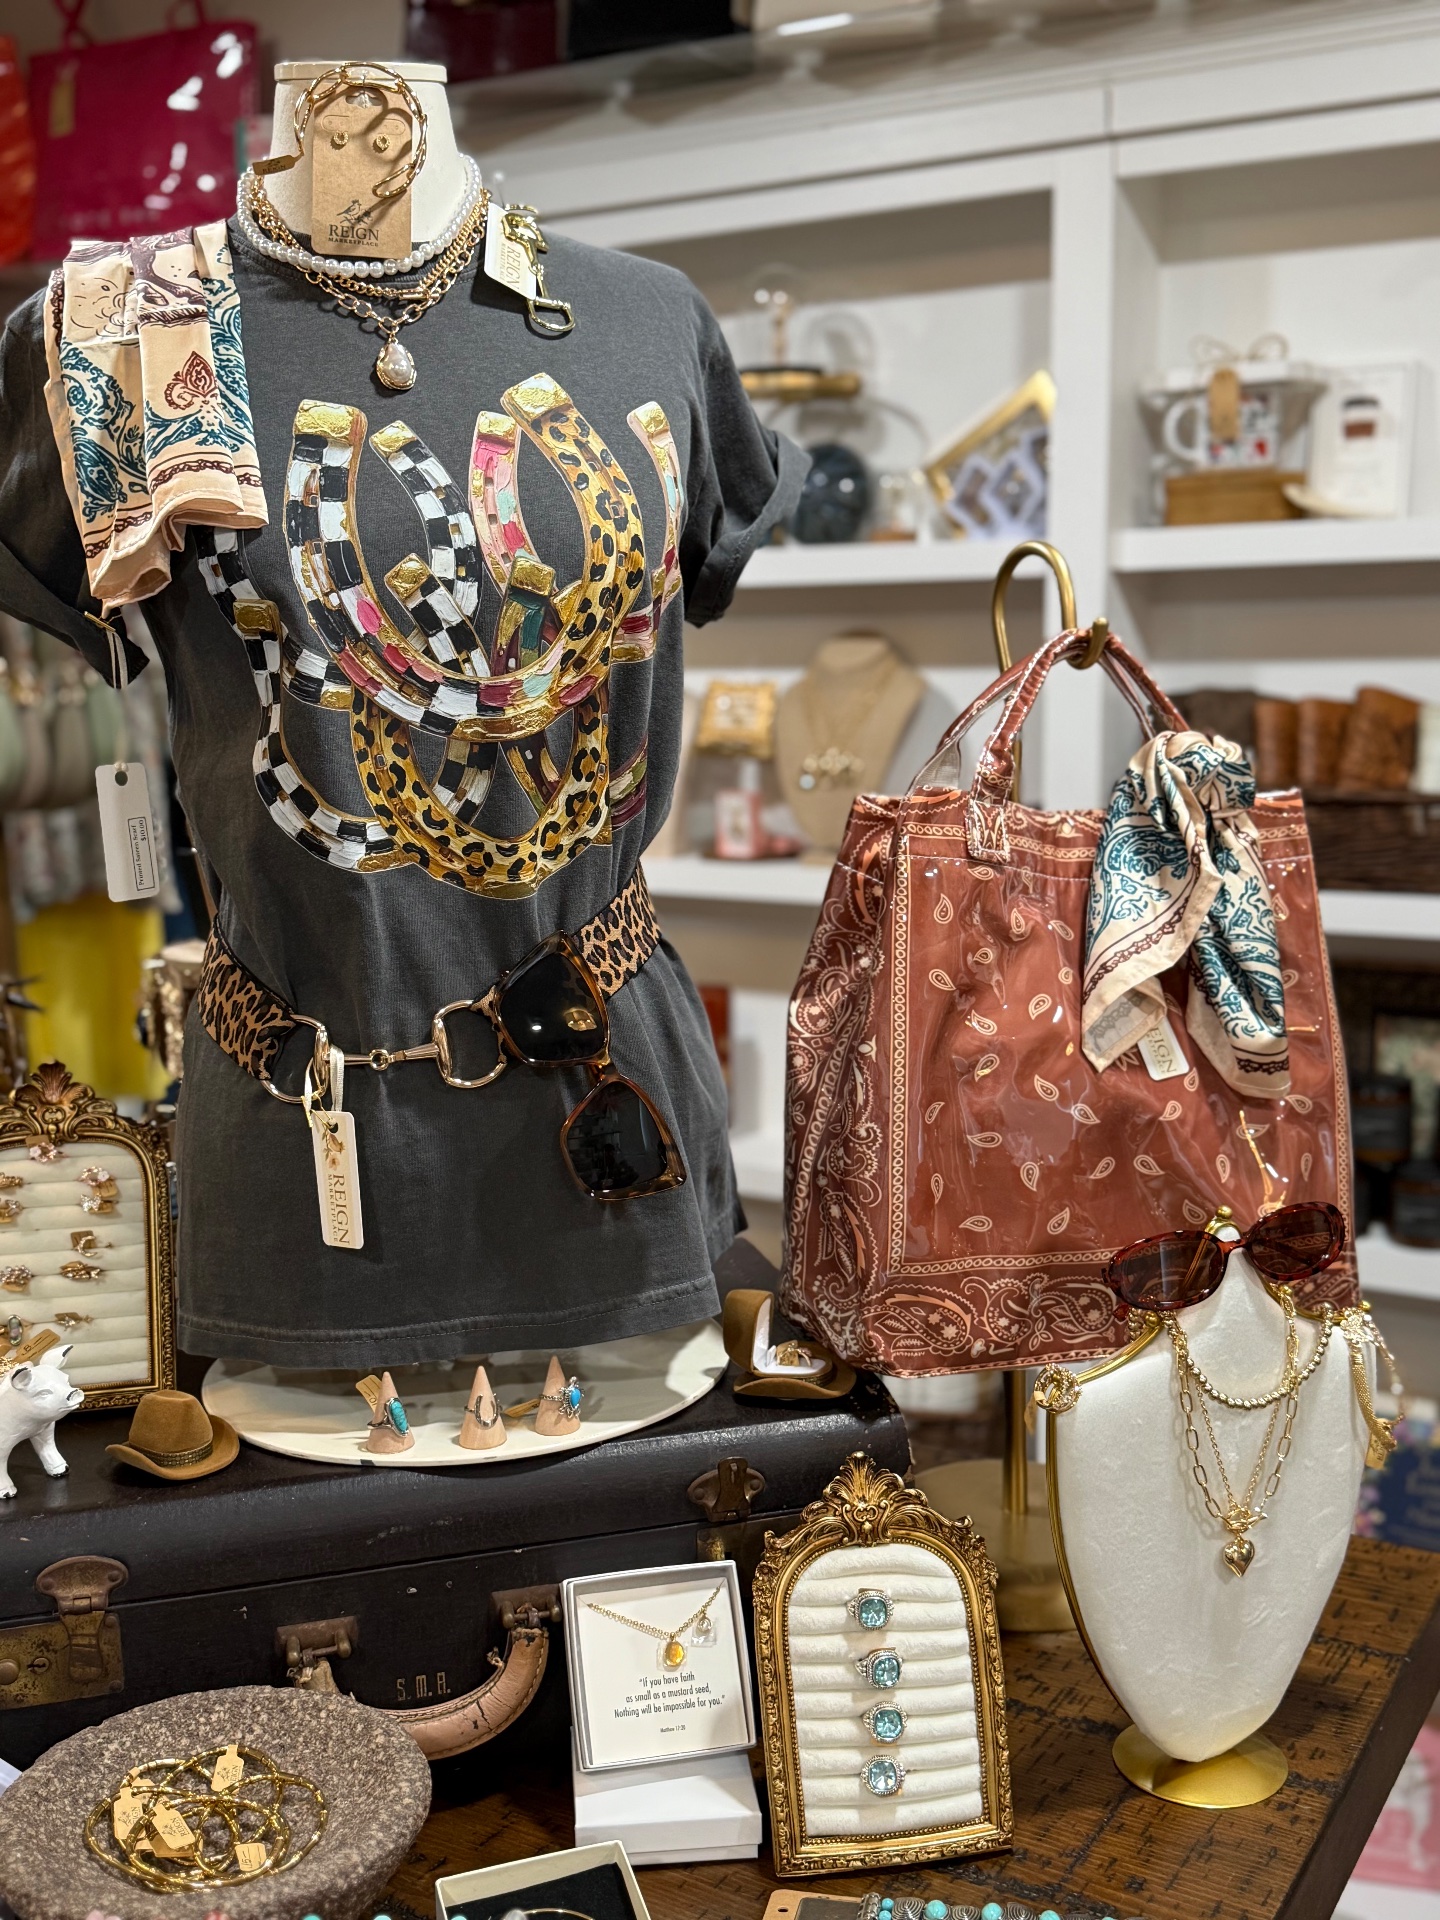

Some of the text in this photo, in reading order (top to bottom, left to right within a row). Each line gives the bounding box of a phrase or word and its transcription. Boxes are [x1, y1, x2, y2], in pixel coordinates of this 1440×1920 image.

[328, 224, 379, 242] REIGN
[328, 237, 379, 248] MARKETPLACE
[506, 246, 521, 290] REIGN
[139, 819, 147, 842] $10.00
[136, 863, 145, 886] Printed
[1150, 1027, 1177, 1073] EIGN
[328, 1174, 339, 1242] MARKETPLACE
[333, 1174, 350, 1245] REIGN
[650, 1679, 662, 1689] you
[663, 1674, 679, 1685] have
[680, 1671, 695, 1681] faith
[626, 1682, 712, 1703] as small as a mustard seed,
[614, 1706, 640, 1719] Nothing
[640, 1703, 652, 1714] will
[653, 1702, 662, 1713] be
[663, 1698, 695, 1713] impossible
[696, 1696, 707, 1707] for
